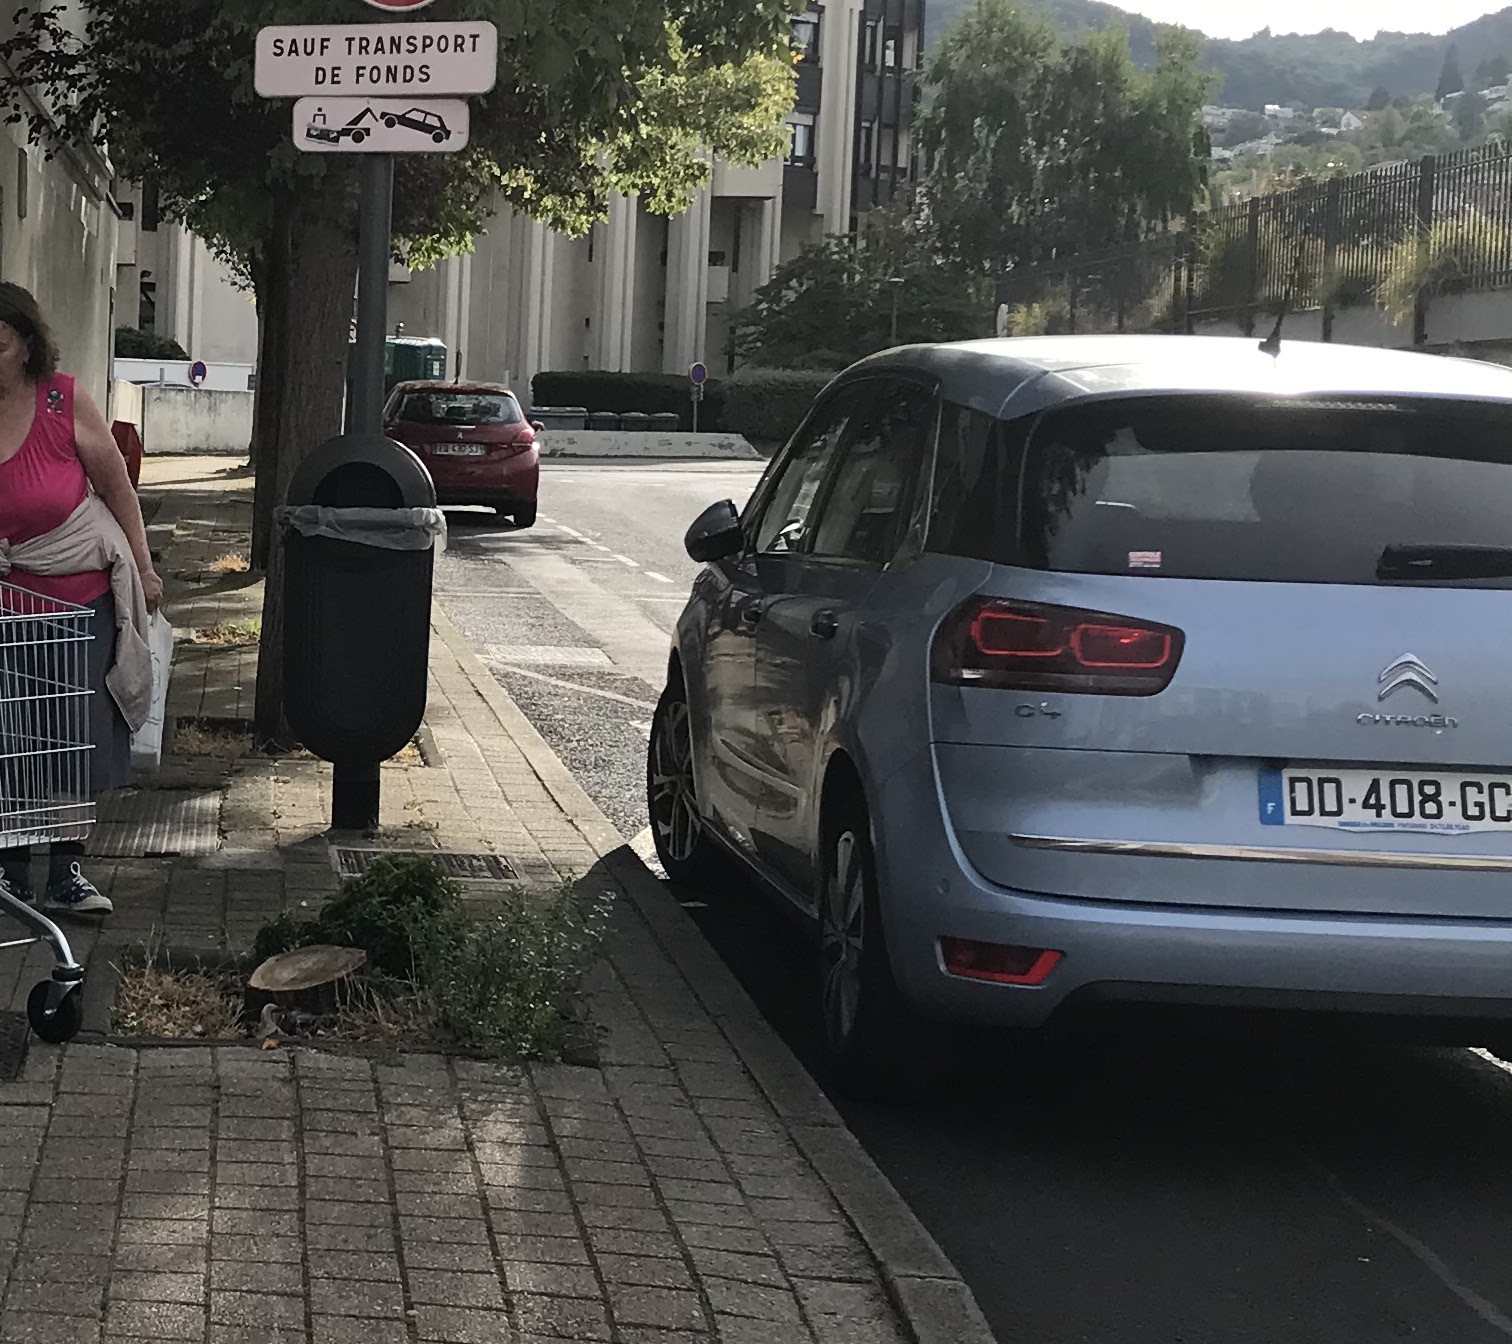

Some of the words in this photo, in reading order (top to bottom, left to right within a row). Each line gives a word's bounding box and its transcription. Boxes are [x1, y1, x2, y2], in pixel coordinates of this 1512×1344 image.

[272, 37, 331, 57] SAUF
[345, 34, 481, 56] TRANSPORT
[314, 66, 341, 85] DE
[355, 64, 431, 85] FONDS
[1015, 702, 1062, 719] C4
[1289, 776, 1512, 823] DD-408-GC
